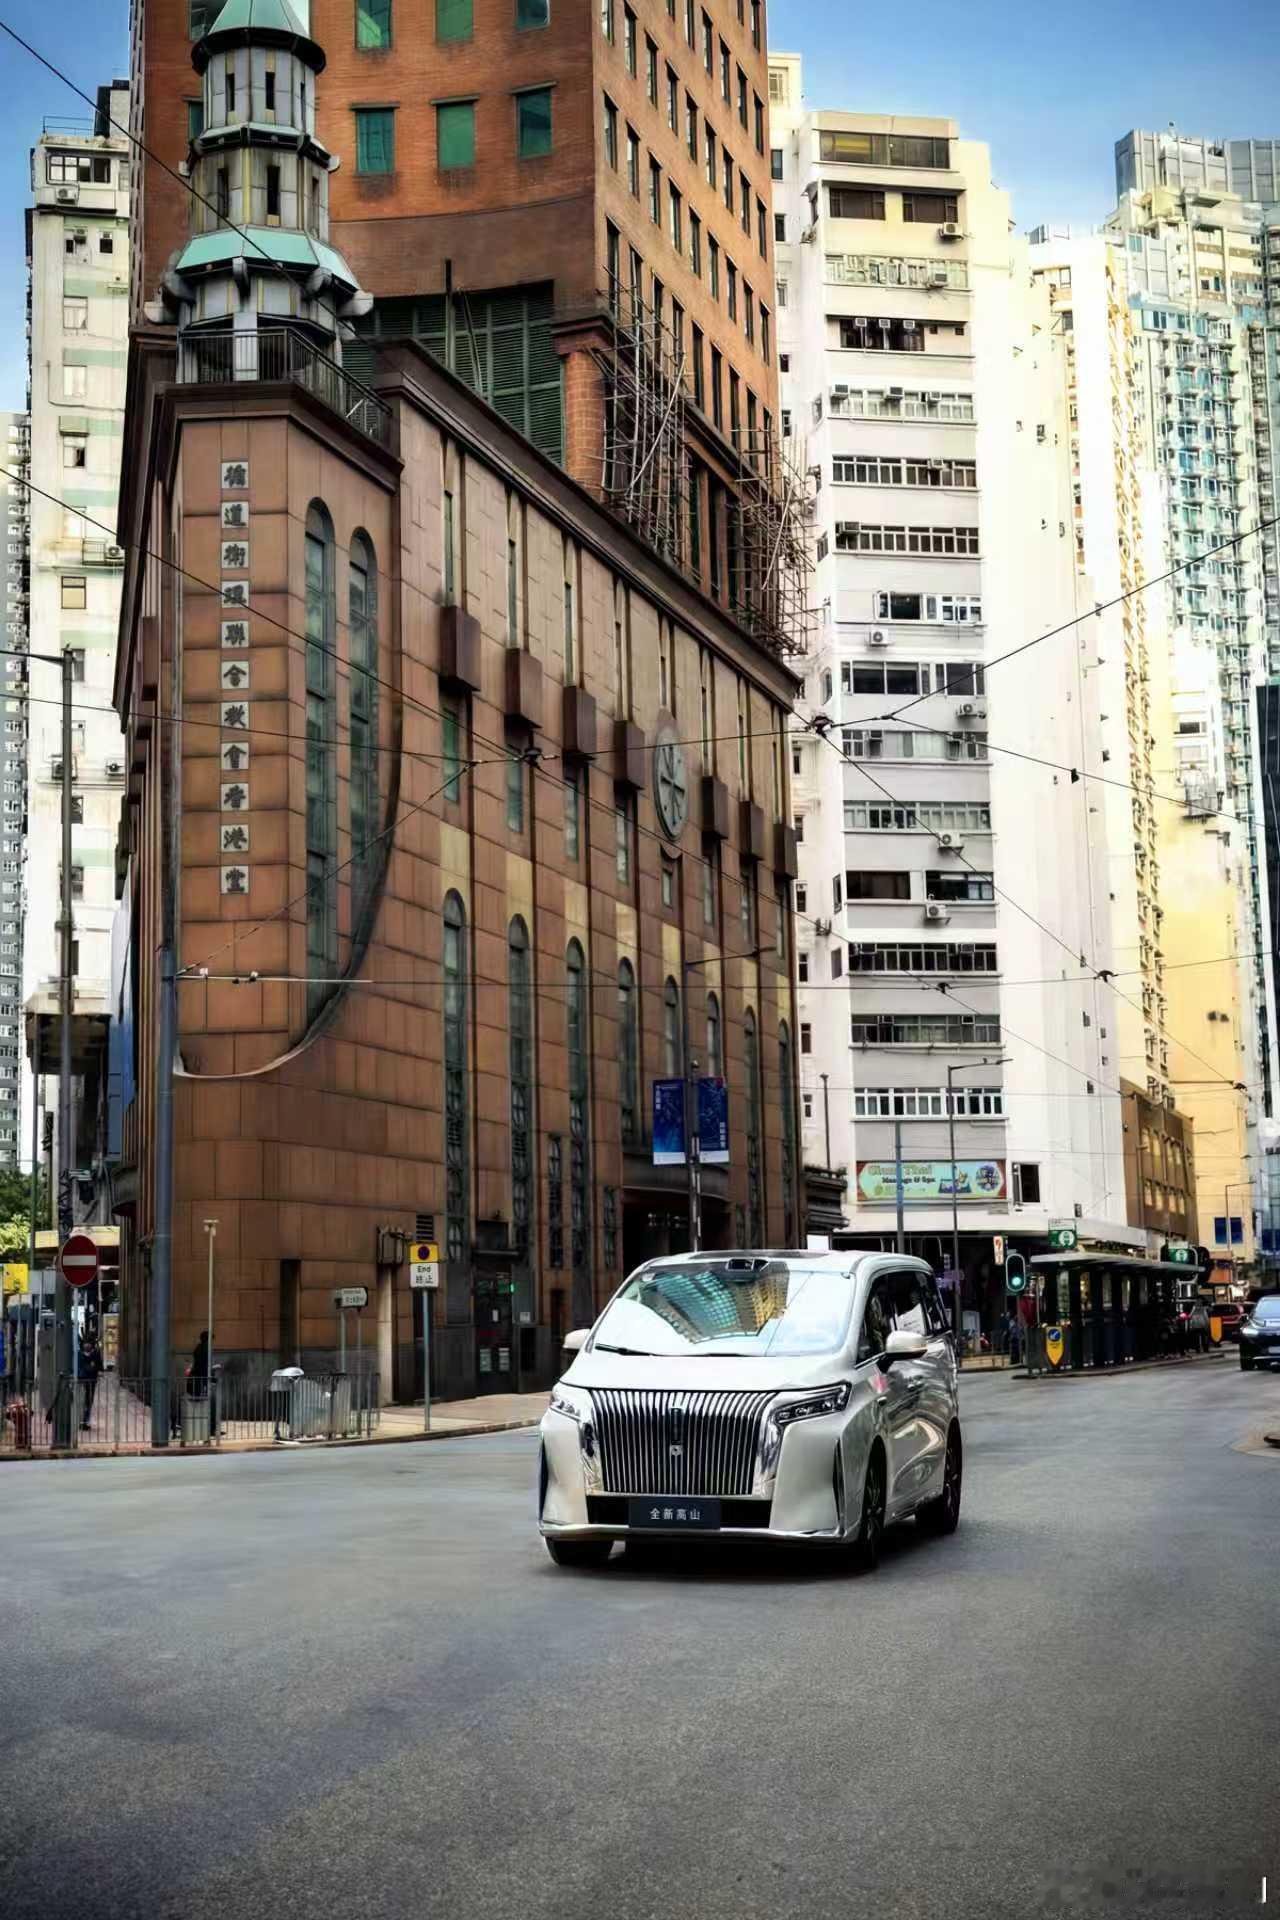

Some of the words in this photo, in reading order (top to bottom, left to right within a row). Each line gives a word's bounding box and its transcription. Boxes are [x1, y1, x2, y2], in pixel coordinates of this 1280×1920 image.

[417, 1265, 431, 1273] End
[650, 1507, 700, 1520] 全新高山
